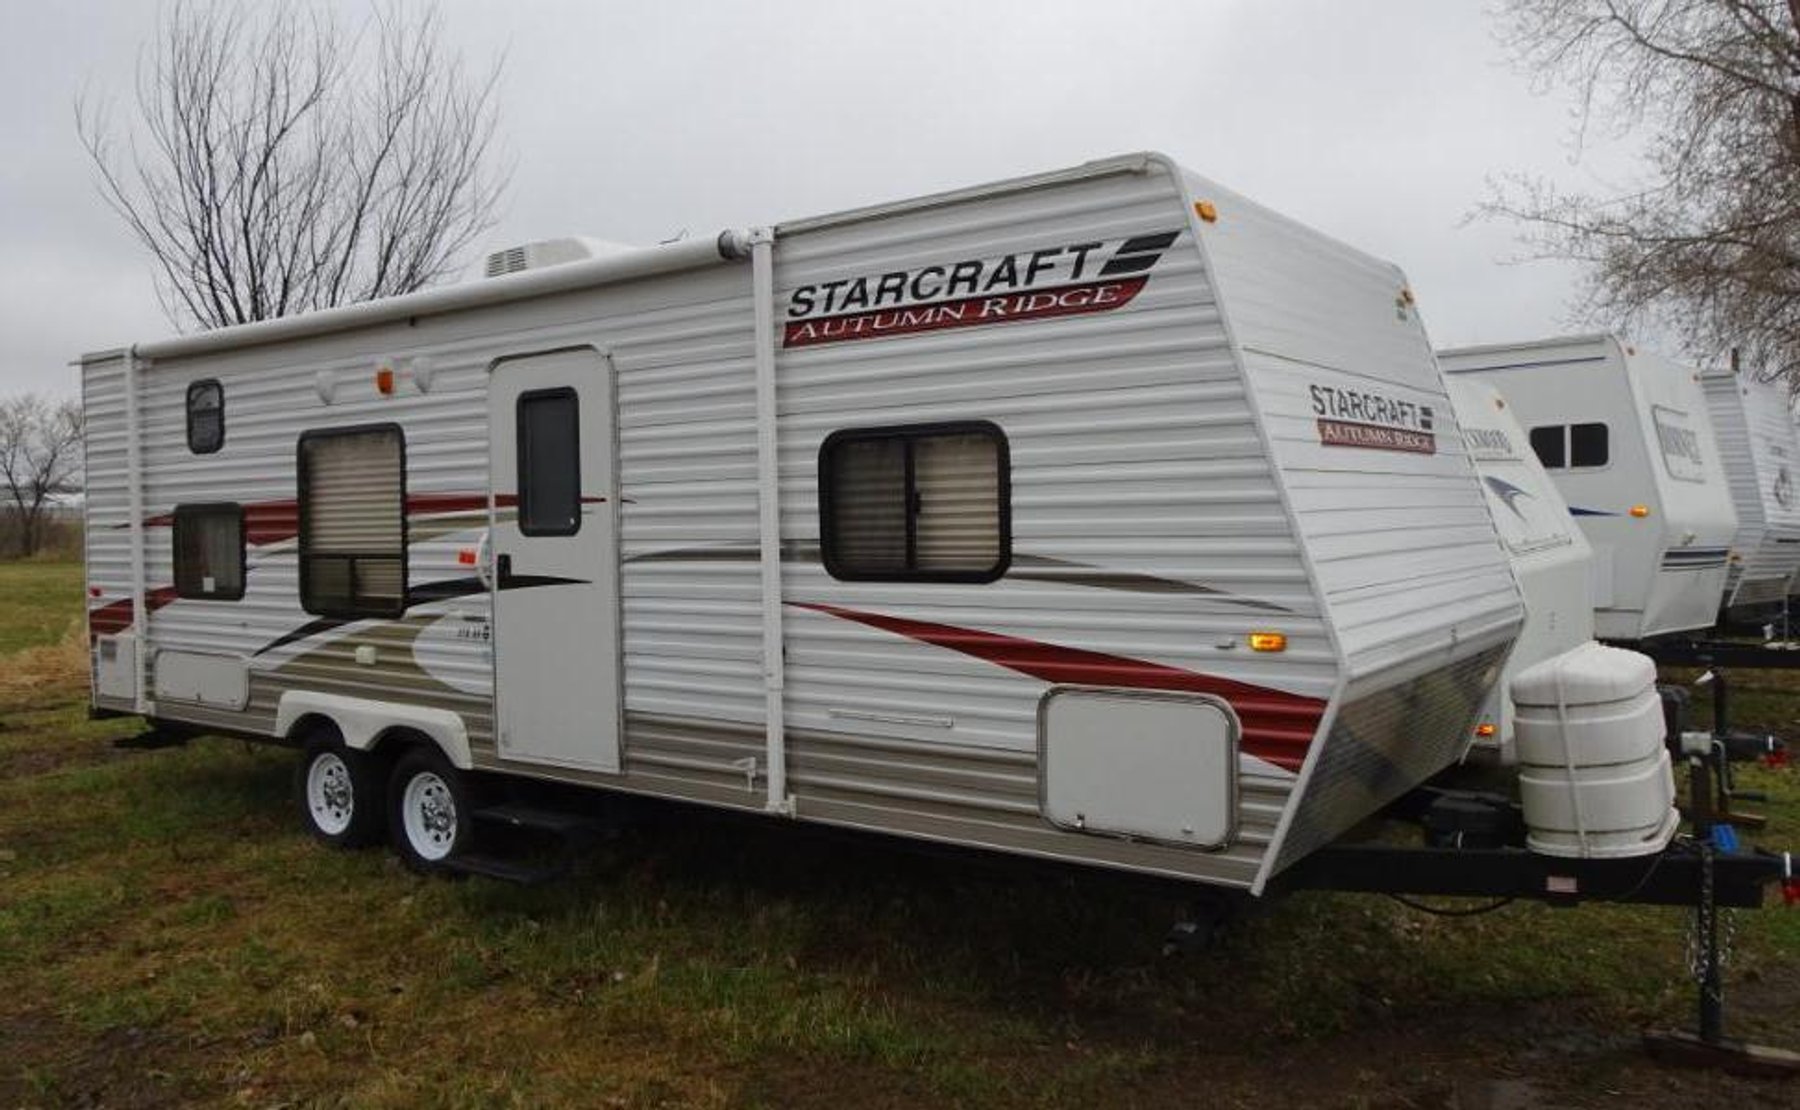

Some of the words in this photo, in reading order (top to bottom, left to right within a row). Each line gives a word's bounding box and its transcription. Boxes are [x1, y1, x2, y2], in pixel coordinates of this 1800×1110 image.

[788, 242, 1103, 318] STARCRAFT
[792, 303, 966, 341] AUTUMN
[978, 284, 1122, 319] RIDGE
[1310, 384, 1417, 427] STARCRAFT
[1324, 425, 1391, 445] AUTUMN
